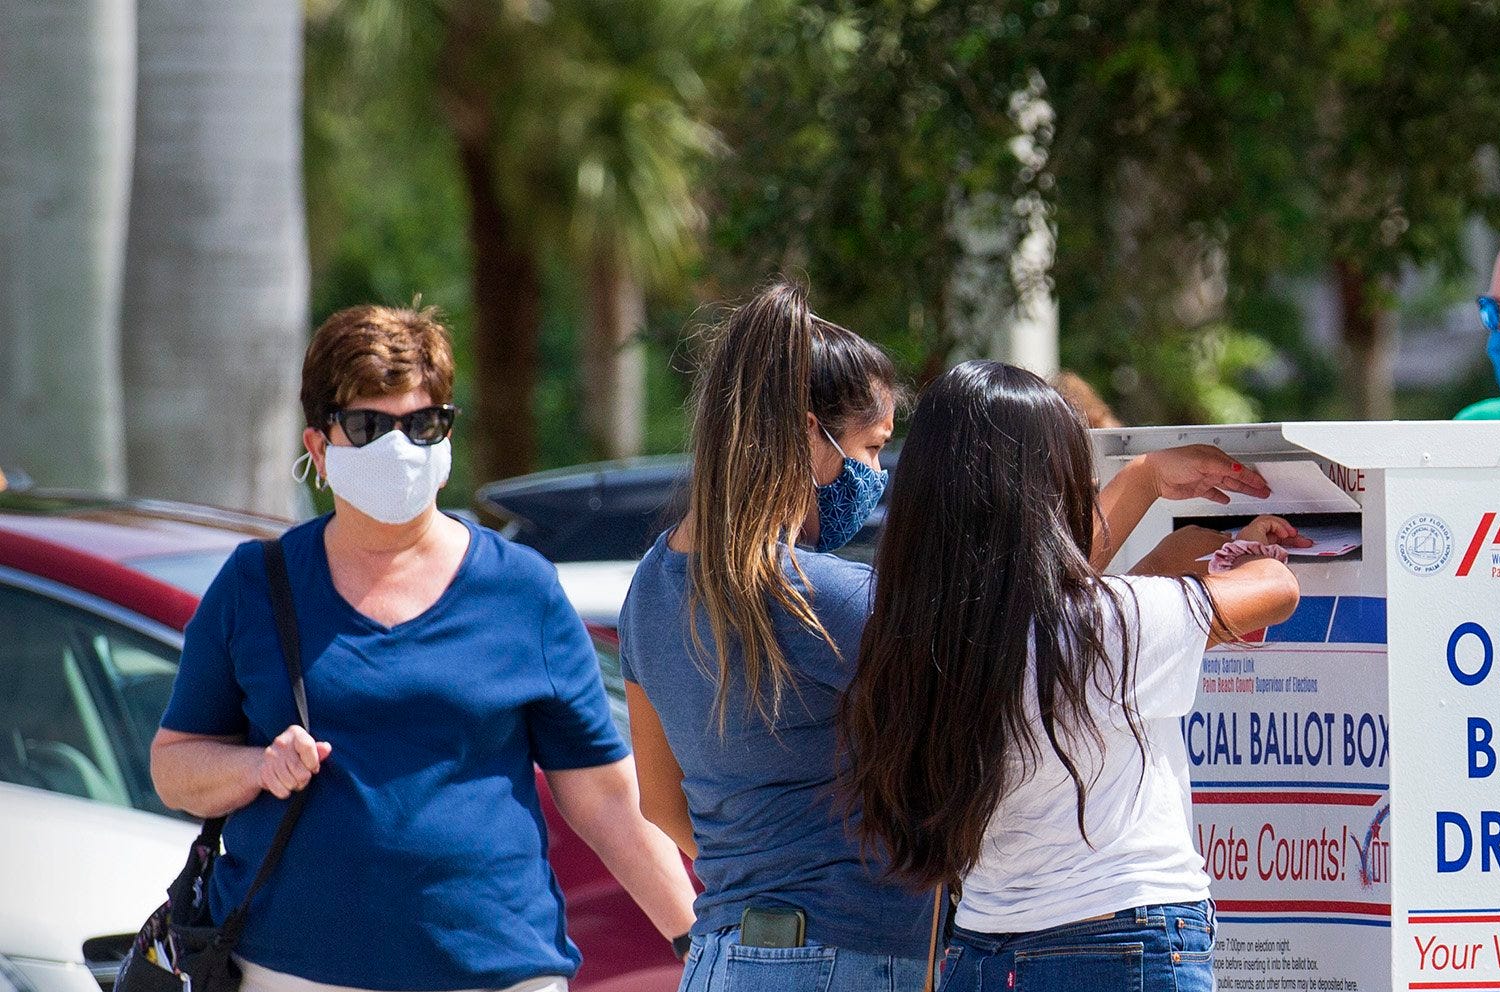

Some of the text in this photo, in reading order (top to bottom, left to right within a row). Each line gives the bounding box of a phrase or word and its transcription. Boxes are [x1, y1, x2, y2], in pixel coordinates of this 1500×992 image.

[1320, 463, 1365, 492] ANCE
[1400, 520, 1416, 540] STATE
[1429, 518, 1450, 540] FLORIDA
[1399, 543, 1413, 567] COUNTY
[1425, 564, 1440, 572] PALM
[1440, 544, 1451, 564] BEACH
[1181, 711, 1389, 768] CIAL BALLOT BOX
[1198, 803, 1389, 889] Vote Counts! VOT
[1413, 934, 1484, 971] Your
